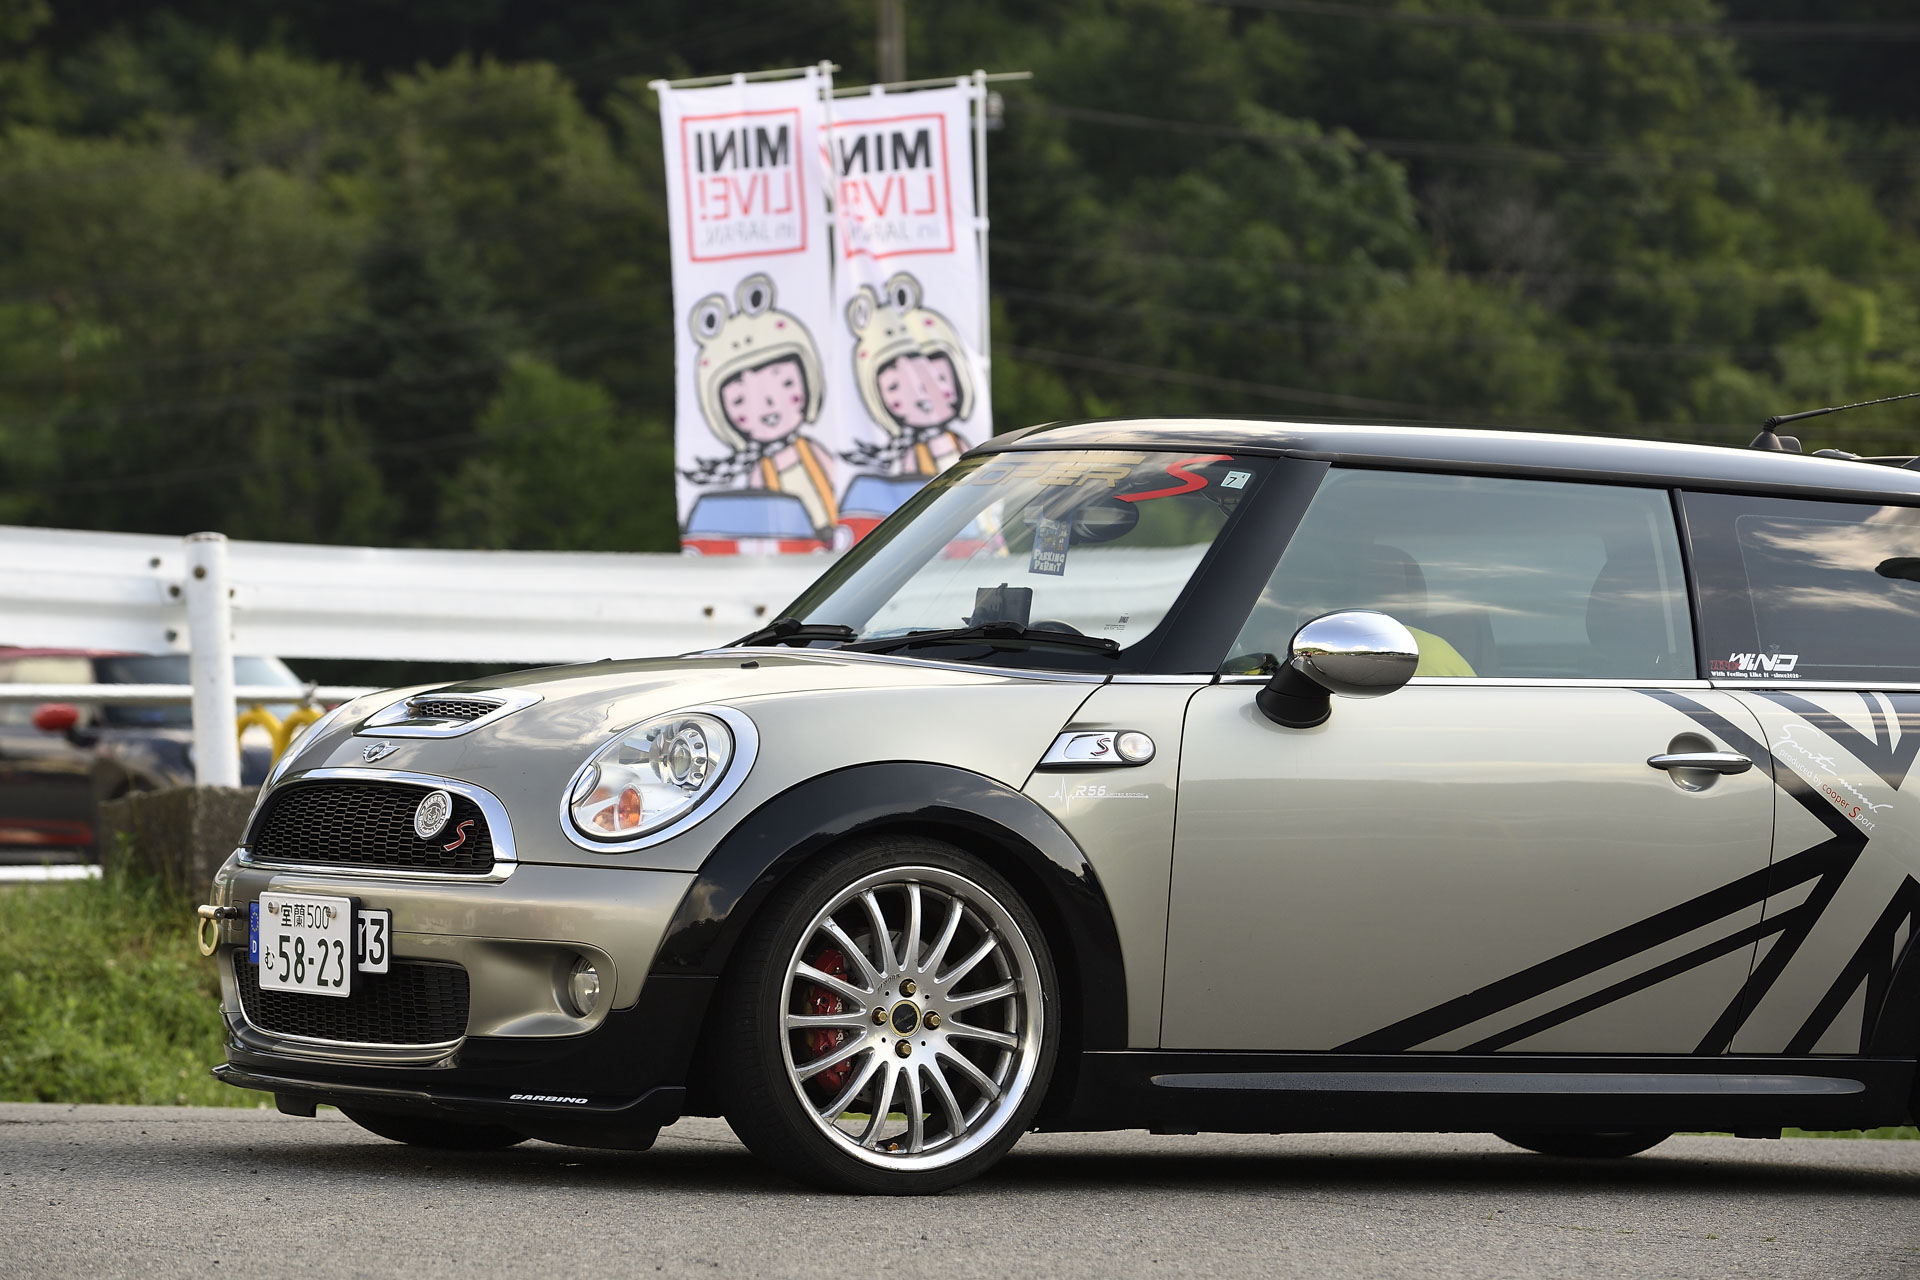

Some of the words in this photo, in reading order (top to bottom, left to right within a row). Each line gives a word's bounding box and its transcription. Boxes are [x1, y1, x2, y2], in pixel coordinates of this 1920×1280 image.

[1227, 476, 1238, 486] 7
[1779, 749, 1813, 778] produced
[1813, 773, 1823, 787] by
[1822, 783, 1850, 809] cooper
[1075, 785, 1107, 797] R56
[264, 945, 275, 970] む
[510, 1094, 588, 1104] GARBINO
